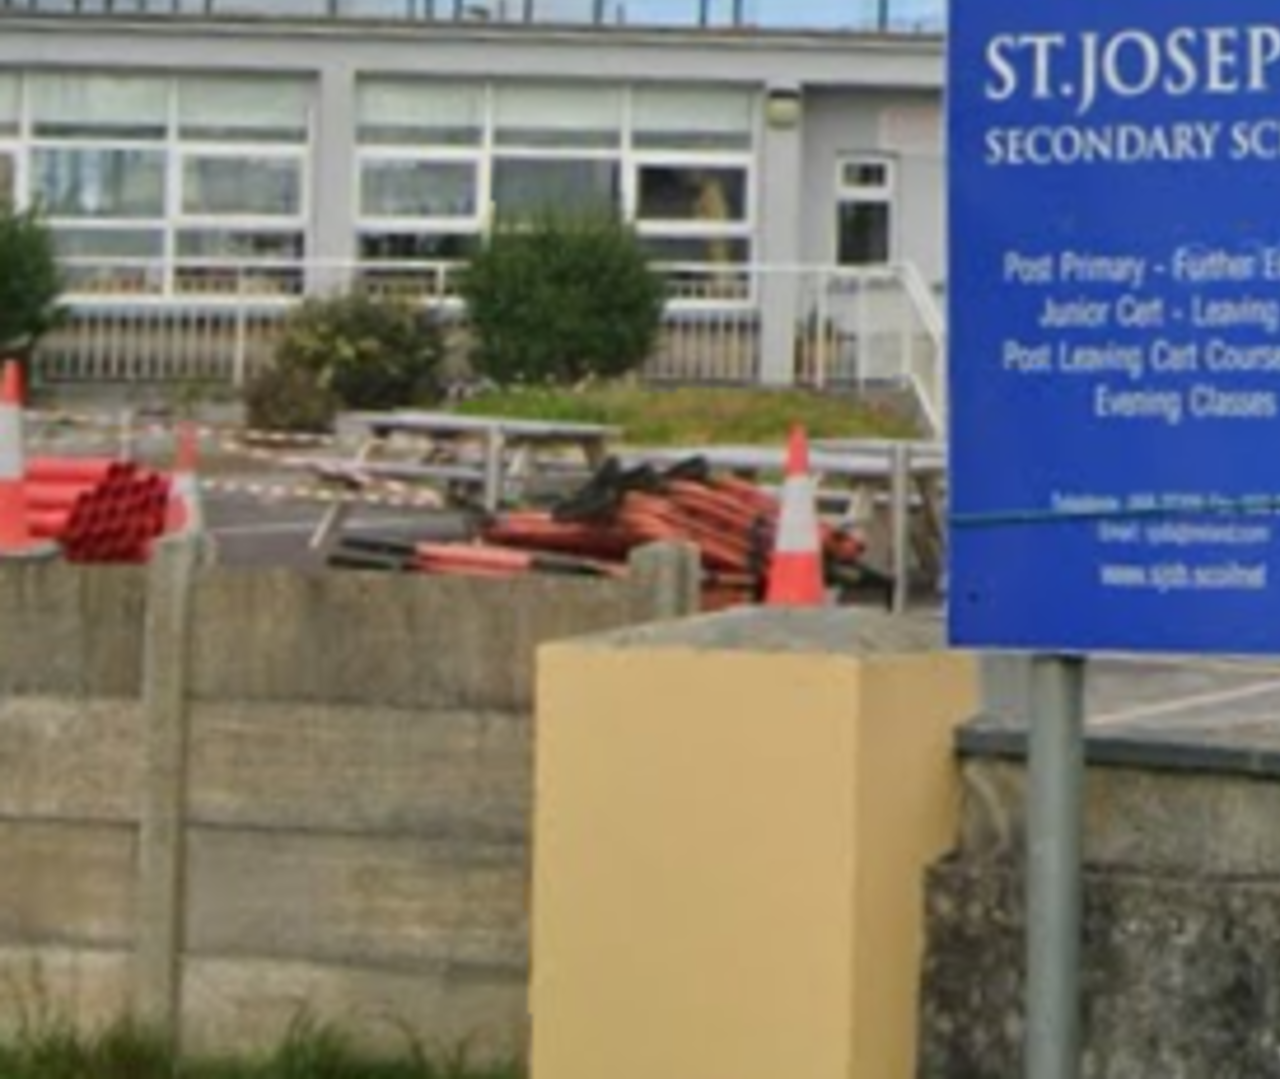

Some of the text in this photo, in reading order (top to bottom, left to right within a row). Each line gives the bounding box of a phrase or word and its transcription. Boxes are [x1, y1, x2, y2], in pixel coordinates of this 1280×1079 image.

[985, 121, 1220, 165] SECONDARY
[1004, 252, 1053, 284] Post
[1060, 251, 1146, 288] Primary
[1171, 247, 1256, 281] Further
[1039, 298, 1110, 328] Junior
[1115, 294, 1164, 327] Cert
[1191, 294, 1280, 333] Leaving
[1003, 340, 1052, 373] Post
[1058, 341, 1144, 380] Leaving
[1149, 337, 1199, 372] Cert
[1094, 383, 1279, 425] Evening Classes
